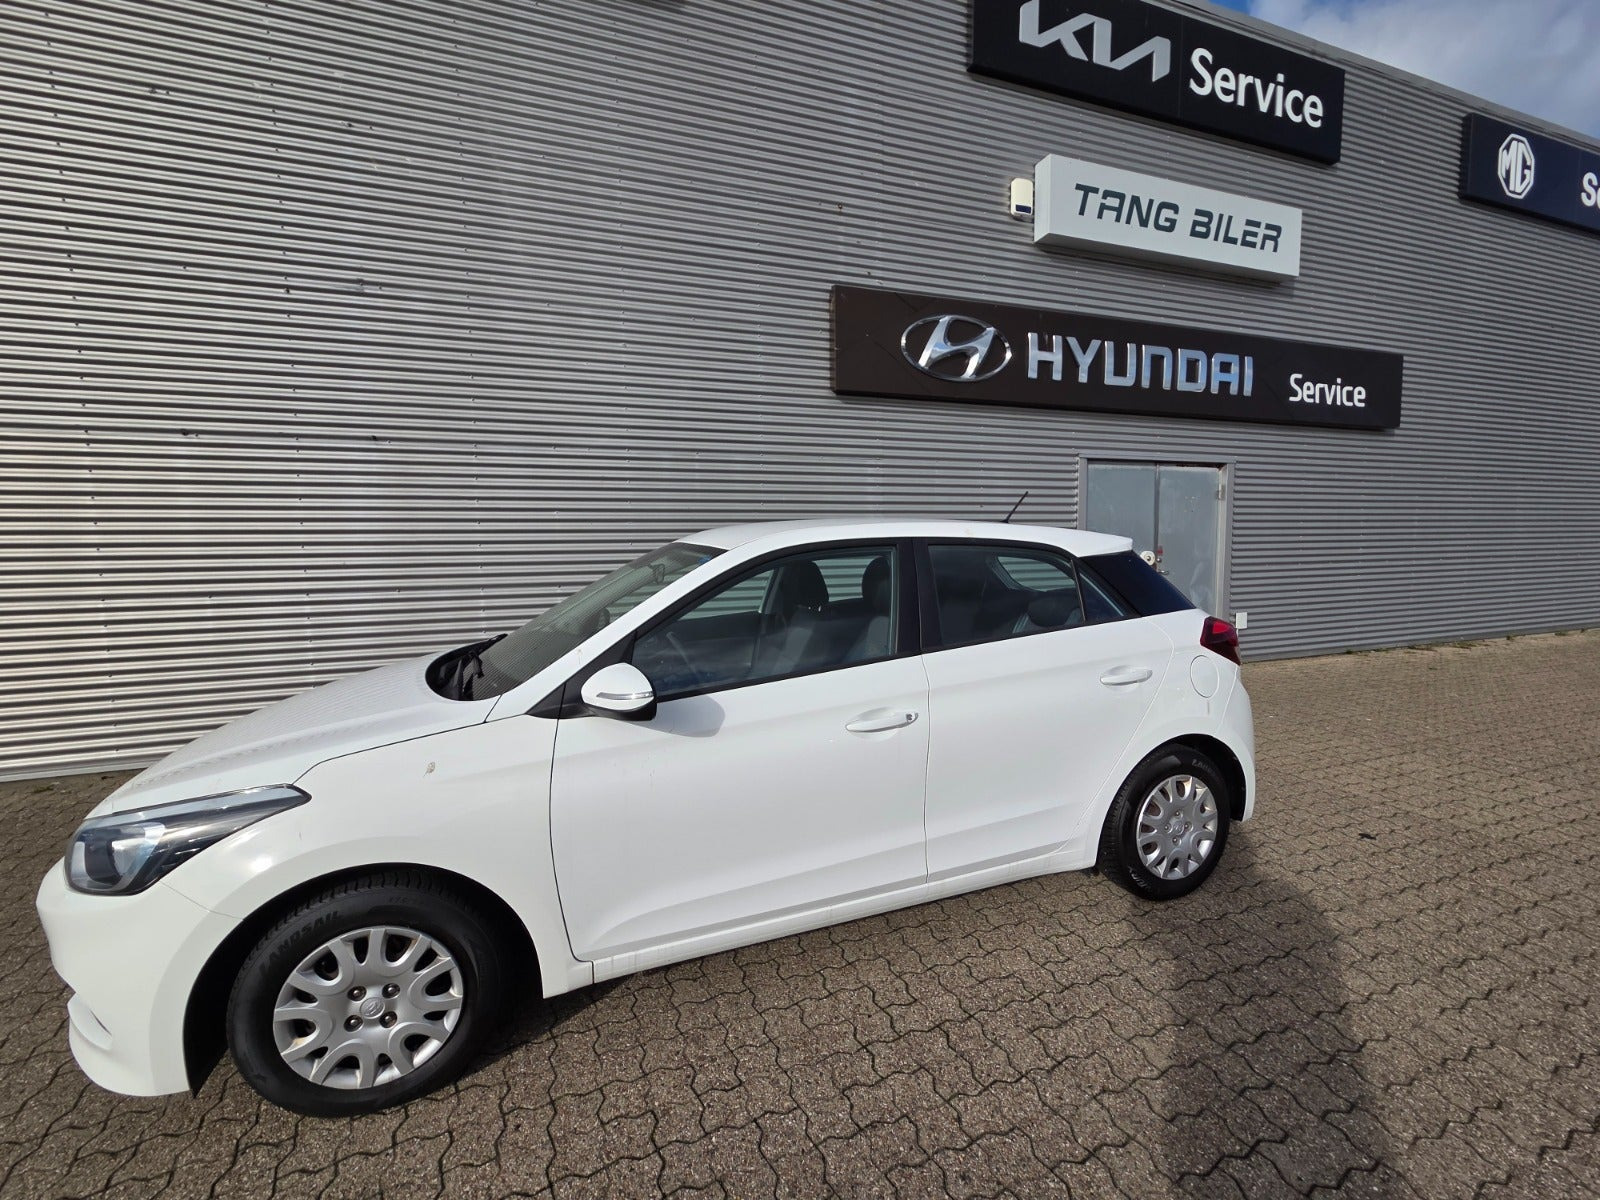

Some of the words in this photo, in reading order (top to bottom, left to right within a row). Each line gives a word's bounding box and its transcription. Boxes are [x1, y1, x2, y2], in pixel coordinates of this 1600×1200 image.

[1019, 0, 1171, 82] KIA
[1189, 48, 1324, 128] Service
[1501, 138, 1533, 195] MG
[1581, 171, 1600, 209] S
[1075, 182, 1179, 233] TANG
[1190, 208, 1282, 253] BILER
[1027, 331, 1253, 397] HYUNDAI
[1289, 373, 1366, 408] Service
